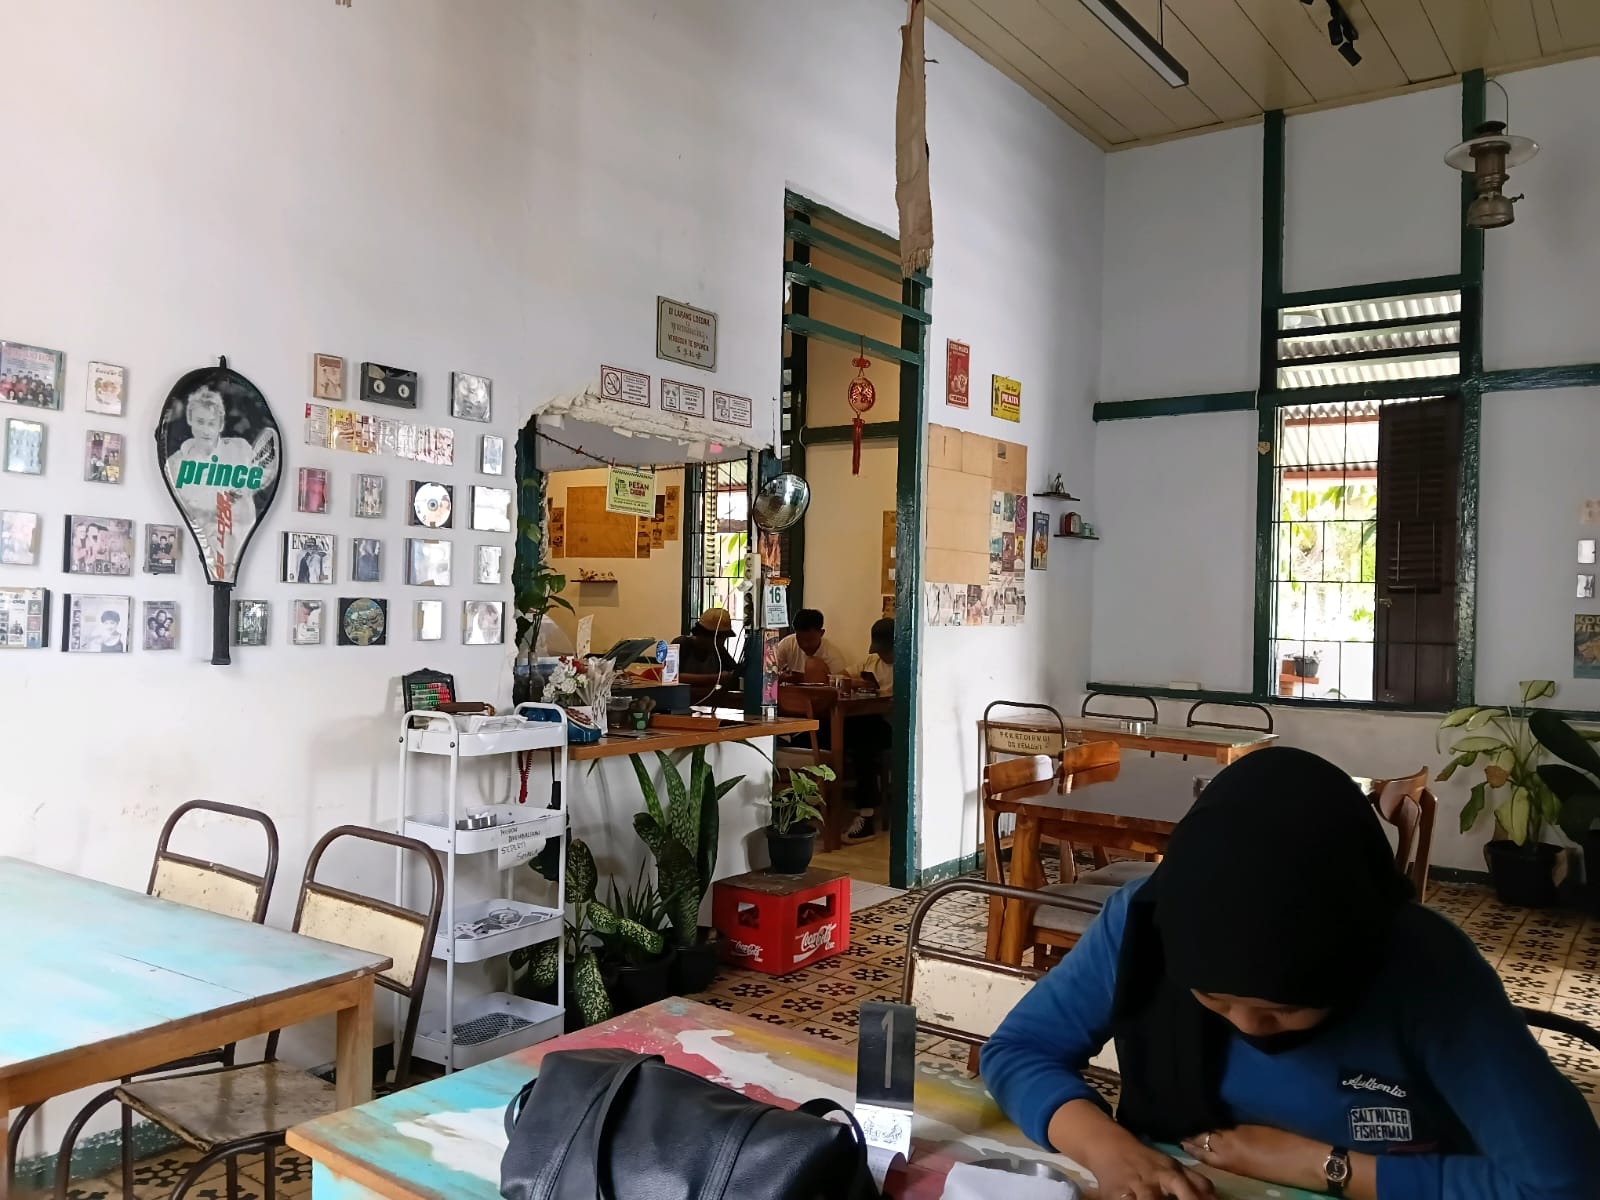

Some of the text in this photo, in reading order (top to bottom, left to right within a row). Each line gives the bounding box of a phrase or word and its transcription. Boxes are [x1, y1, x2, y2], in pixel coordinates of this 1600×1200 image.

[175, 454, 264, 490] prince
[628, 480, 650, 490] PESAN
[769, 586, 781, 604] 16
[881, 1009, 895, 1089] 1
[1342, 1073, 1407, 1098] Authentic
